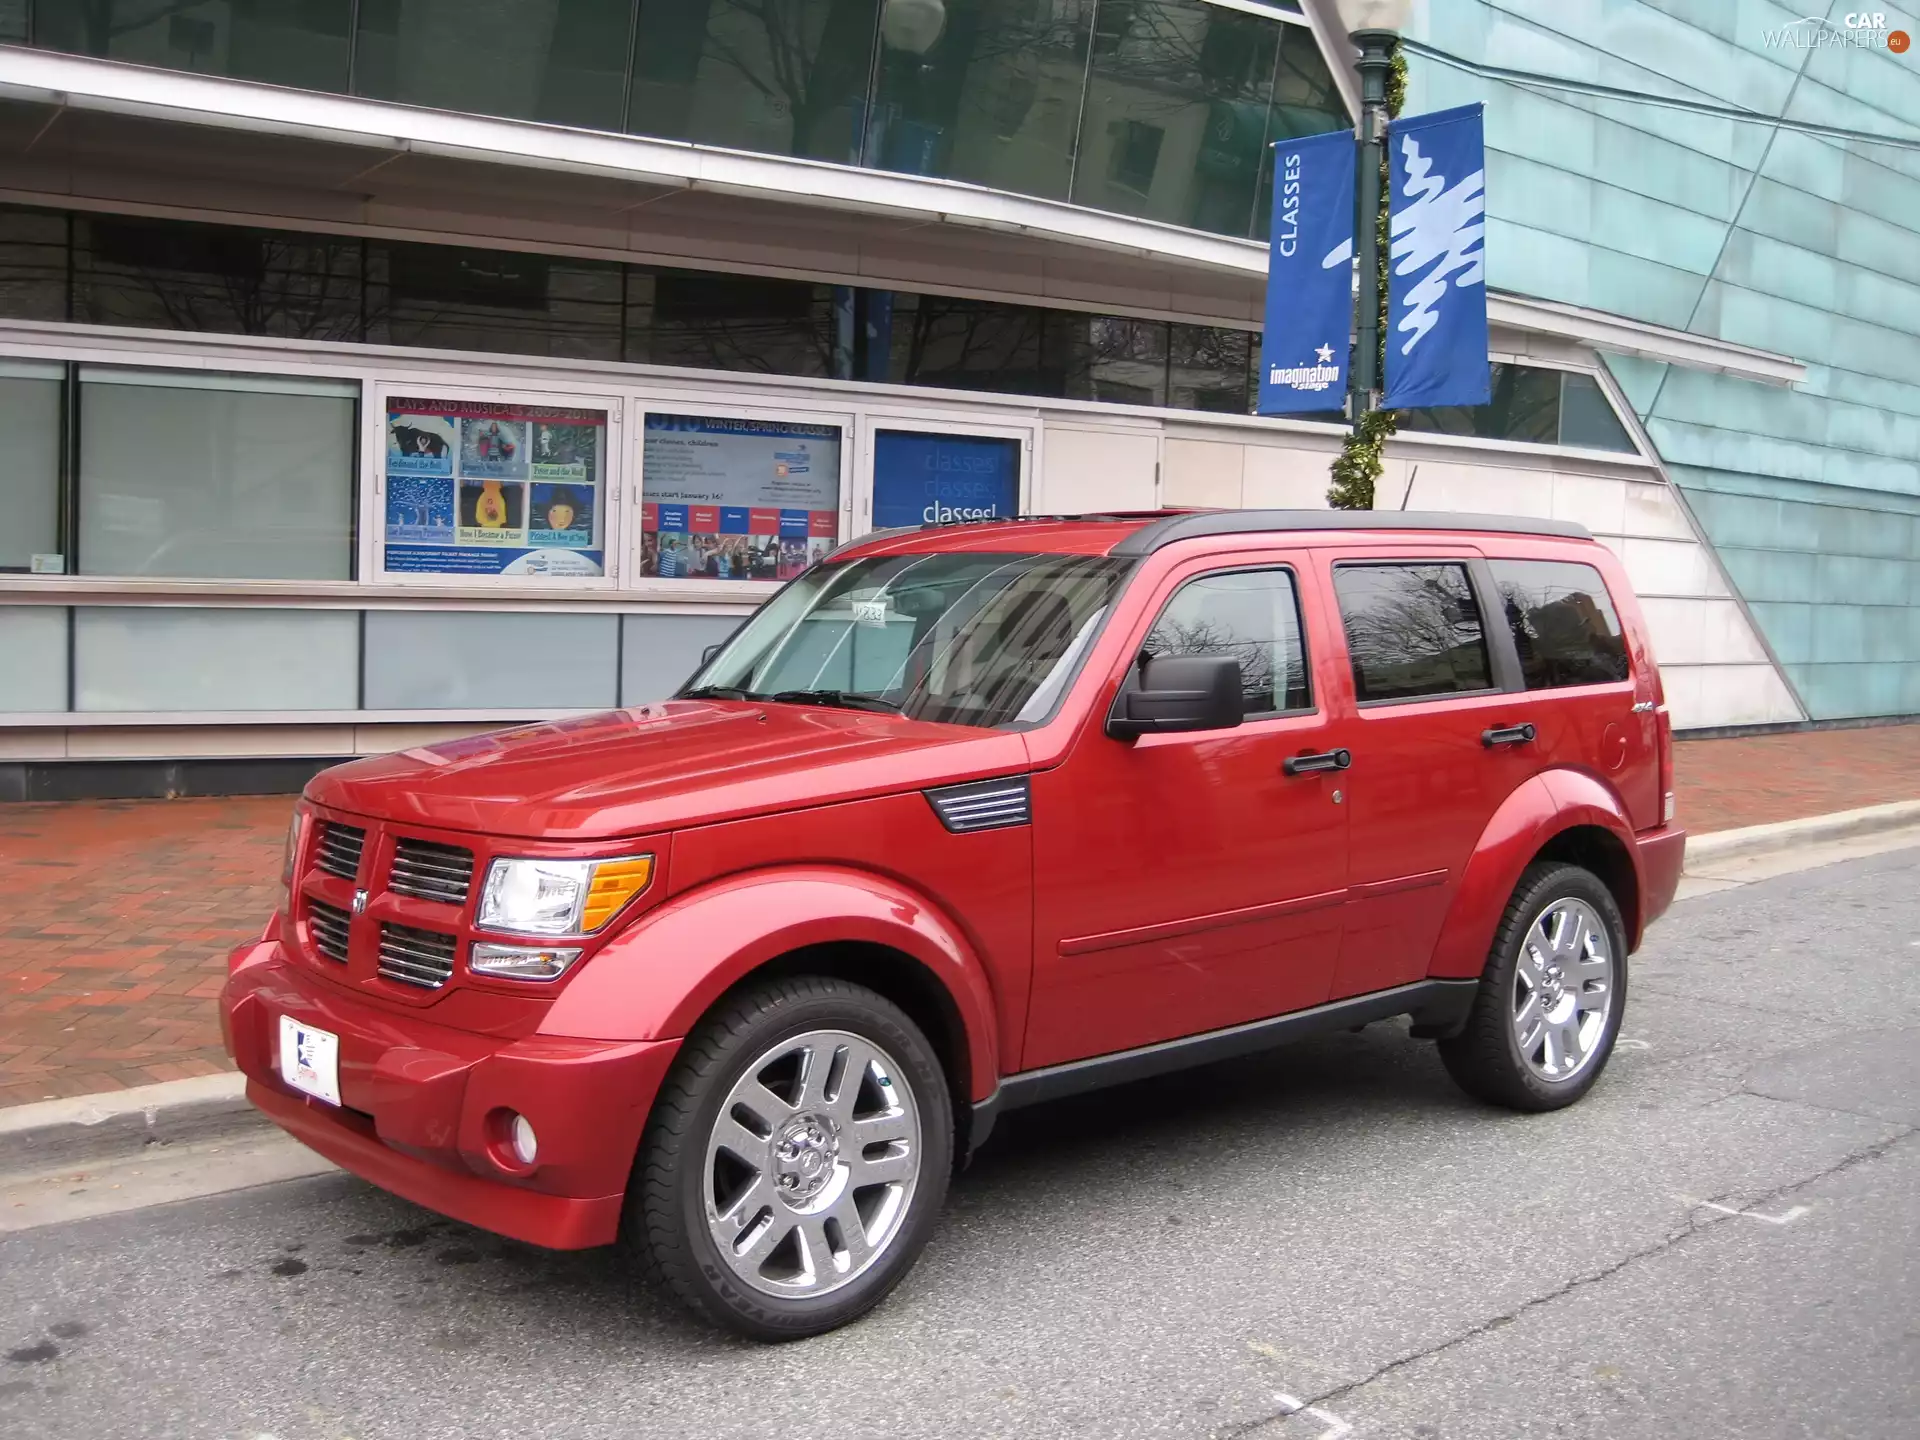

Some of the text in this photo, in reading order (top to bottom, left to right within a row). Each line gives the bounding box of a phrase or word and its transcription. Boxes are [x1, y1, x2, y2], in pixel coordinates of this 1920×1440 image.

[1280, 154, 1300, 257] CLASSES
[1270, 363, 1339, 388] imagination
[1297, 382, 1329, 391] stage
[431, 400, 457, 411] AND
